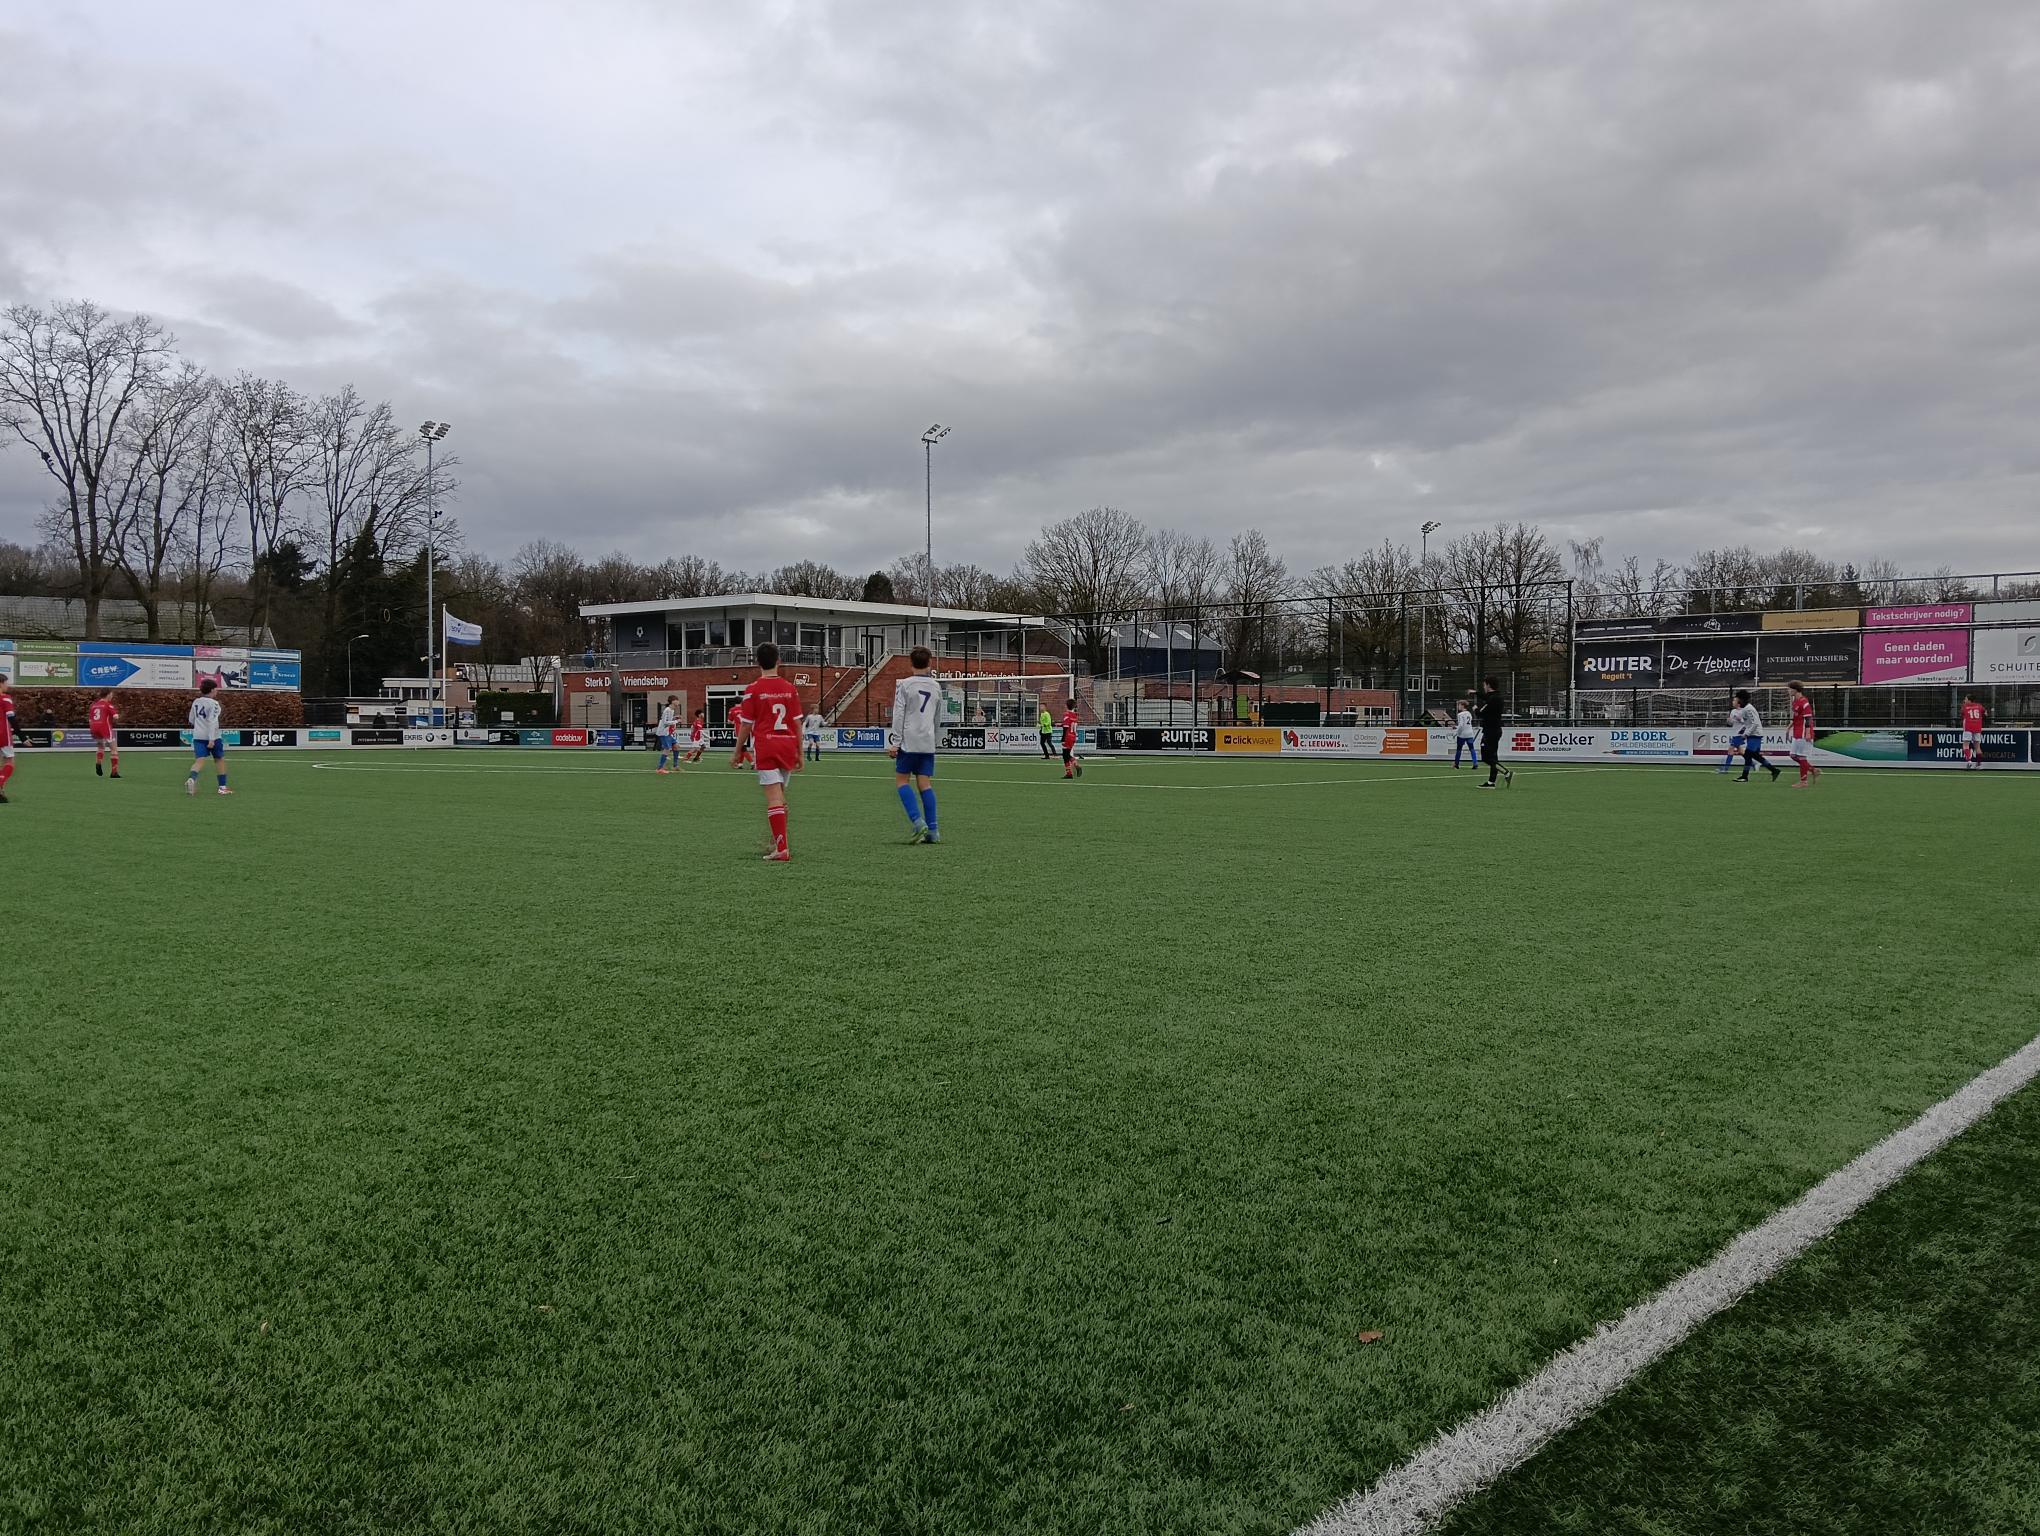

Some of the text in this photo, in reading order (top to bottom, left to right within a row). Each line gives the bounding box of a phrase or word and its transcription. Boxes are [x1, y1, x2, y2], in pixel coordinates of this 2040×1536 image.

[1872, 608, 1964, 621] Tekstschrijver nodig?
[1884, 640, 1946, 653] Geen daden
[1583, 656, 1653, 672] RUITER
[1667, 655, 1751, 674] De Hebberd
[1766, 654, 1850, 664] INTERIOR FINISHERS
[1876, 652, 1954, 666] maar woorden!
[90, 664, 119, 675] CREW
[585, 677, 604, 688] Sterk
[623, 676, 669, 688] Vriendschap
[917, 690, 932, 713] 7
[93, 708, 101, 721] 3
[194, 704, 207, 719] 14
[772, 703, 789, 731] 2
[1967, 709, 1980, 719] 16
[129, 732, 168, 740] SOHOME
[251, 730, 285, 746] jigler
[857, 730, 880, 741] Primera
[1021, 733, 1037, 742] Tech
[1161, 730, 1209, 743] RUITER
[1538, 733, 1595, 746] Dekker
[1610, 731, 1668, 742] DE BOER
[1308, 740, 1341, 748] LEEUWIS
